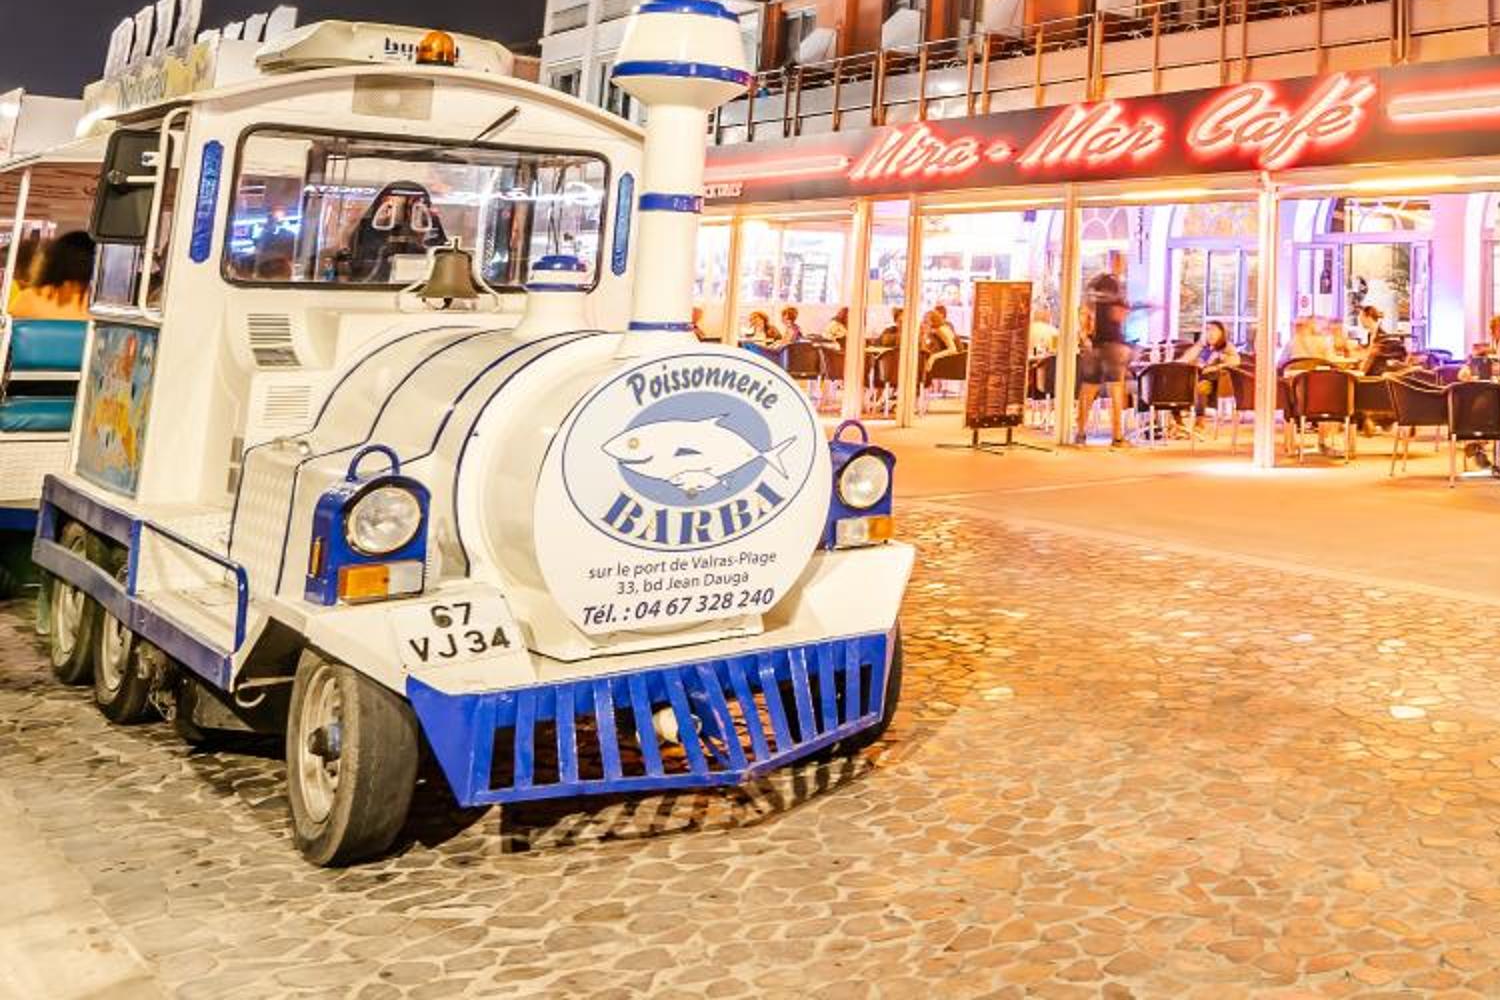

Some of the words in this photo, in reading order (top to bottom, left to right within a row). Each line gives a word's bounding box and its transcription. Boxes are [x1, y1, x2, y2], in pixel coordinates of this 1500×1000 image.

[1189, 72, 1376, 171] Café
[625, 365, 779, 410] Poissonnerie
[601, 481, 785, 545] BARBA
[589, 566, 612, 579] sur
[617, 562, 630, 576] le
[633, 560, 666, 578] port
[669, 557, 688, 572] de
[691, 551, 777, 570] Valras-Plage
[643, 577, 663, 593] bd
[666, 574, 700, 591] Jean
[430, 602, 471, 628] 67
[635, 601, 661, 620] 04
[665, 597, 692, 616] 67
[696, 592, 734, 613] 328
[737, 587, 774, 608] 240
